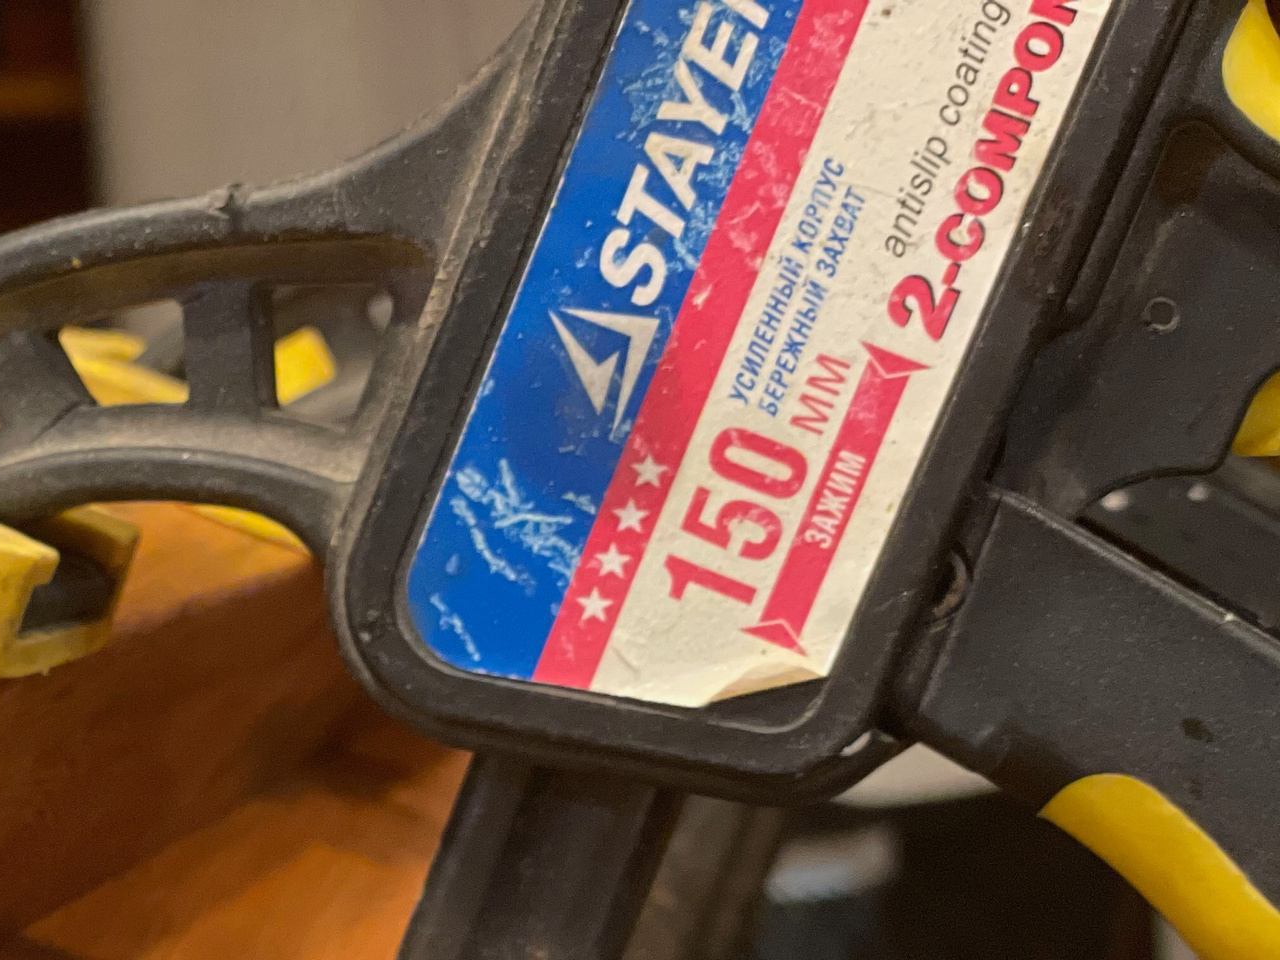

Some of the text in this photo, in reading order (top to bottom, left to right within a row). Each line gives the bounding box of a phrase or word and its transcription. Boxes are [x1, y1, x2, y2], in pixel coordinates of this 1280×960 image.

[885, 0, 1012, 258] antislip coating
[728, 157, 844, 405] УСИЛЕННЫЙ КОРПУС
[758, 186, 867, 417] БЕРЕЖНЫЙ ЗАХВАТ
[663, 353, 853, 606] 150 ММ
[803, 450, 867, 549] ЗАЖИМ
